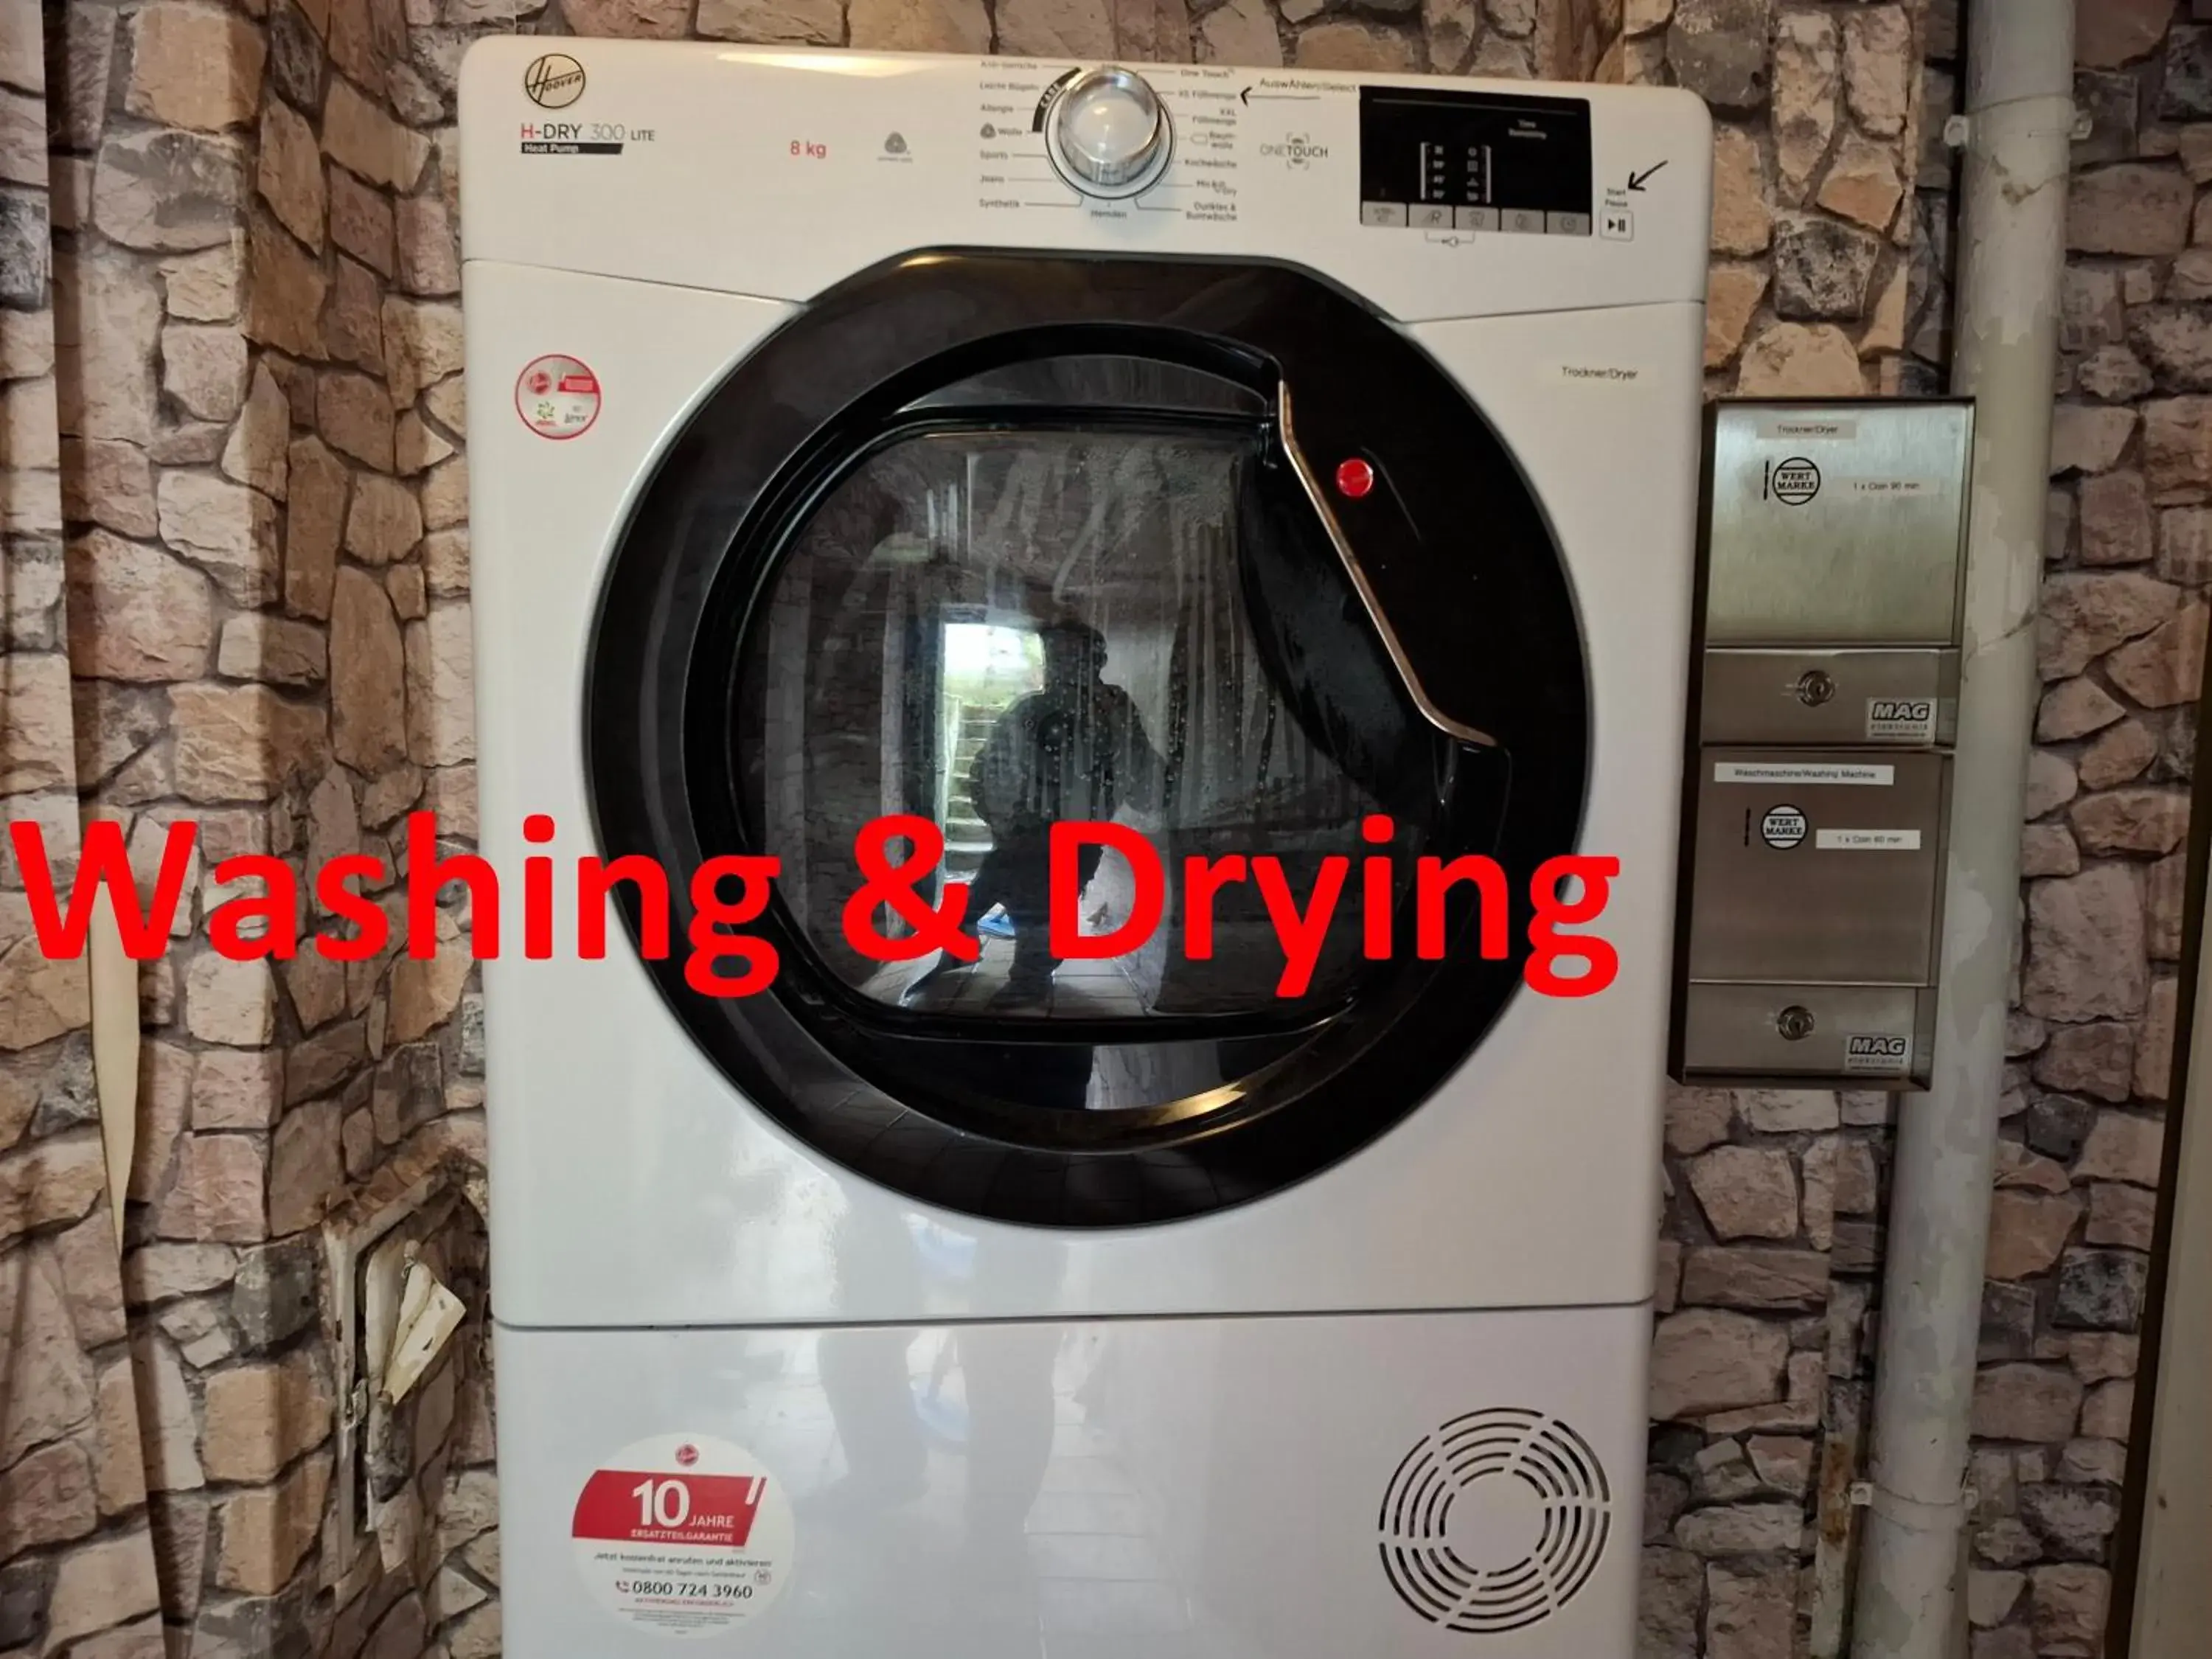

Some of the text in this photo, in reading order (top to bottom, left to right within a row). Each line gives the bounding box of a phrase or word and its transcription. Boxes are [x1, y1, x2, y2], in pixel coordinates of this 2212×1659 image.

[521, 122, 655, 142] H-DRY 300 LITE
[998, 127, 1023, 136] Wolle
[524, 142, 579, 153] Heat Pump
[790, 139, 827, 159] 8 kg
[979, 150, 1008, 160] Sports
[979, 174, 1005, 183] Jeans
[978, 198, 1020, 209] Synthetik
[1091, 209, 1127, 219] Hemden
[1781, 472, 1811, 480] WERT
[1778, 481, 1815, 490] MARKE
[1873, 702, 1930, 720] MAG
[1770, 818, 1799, 827] WERT
[1767, 827, 1802, 835] MARKE
[1850, 1037, 1905, 1055] MAG
[632, 1478, 735, 1528] 10 JAHRE
[630, 1528, 733, 1543] ERSATZTEILGARANTIE
[633, 1581, 753, 1599] 0800 724 3960
